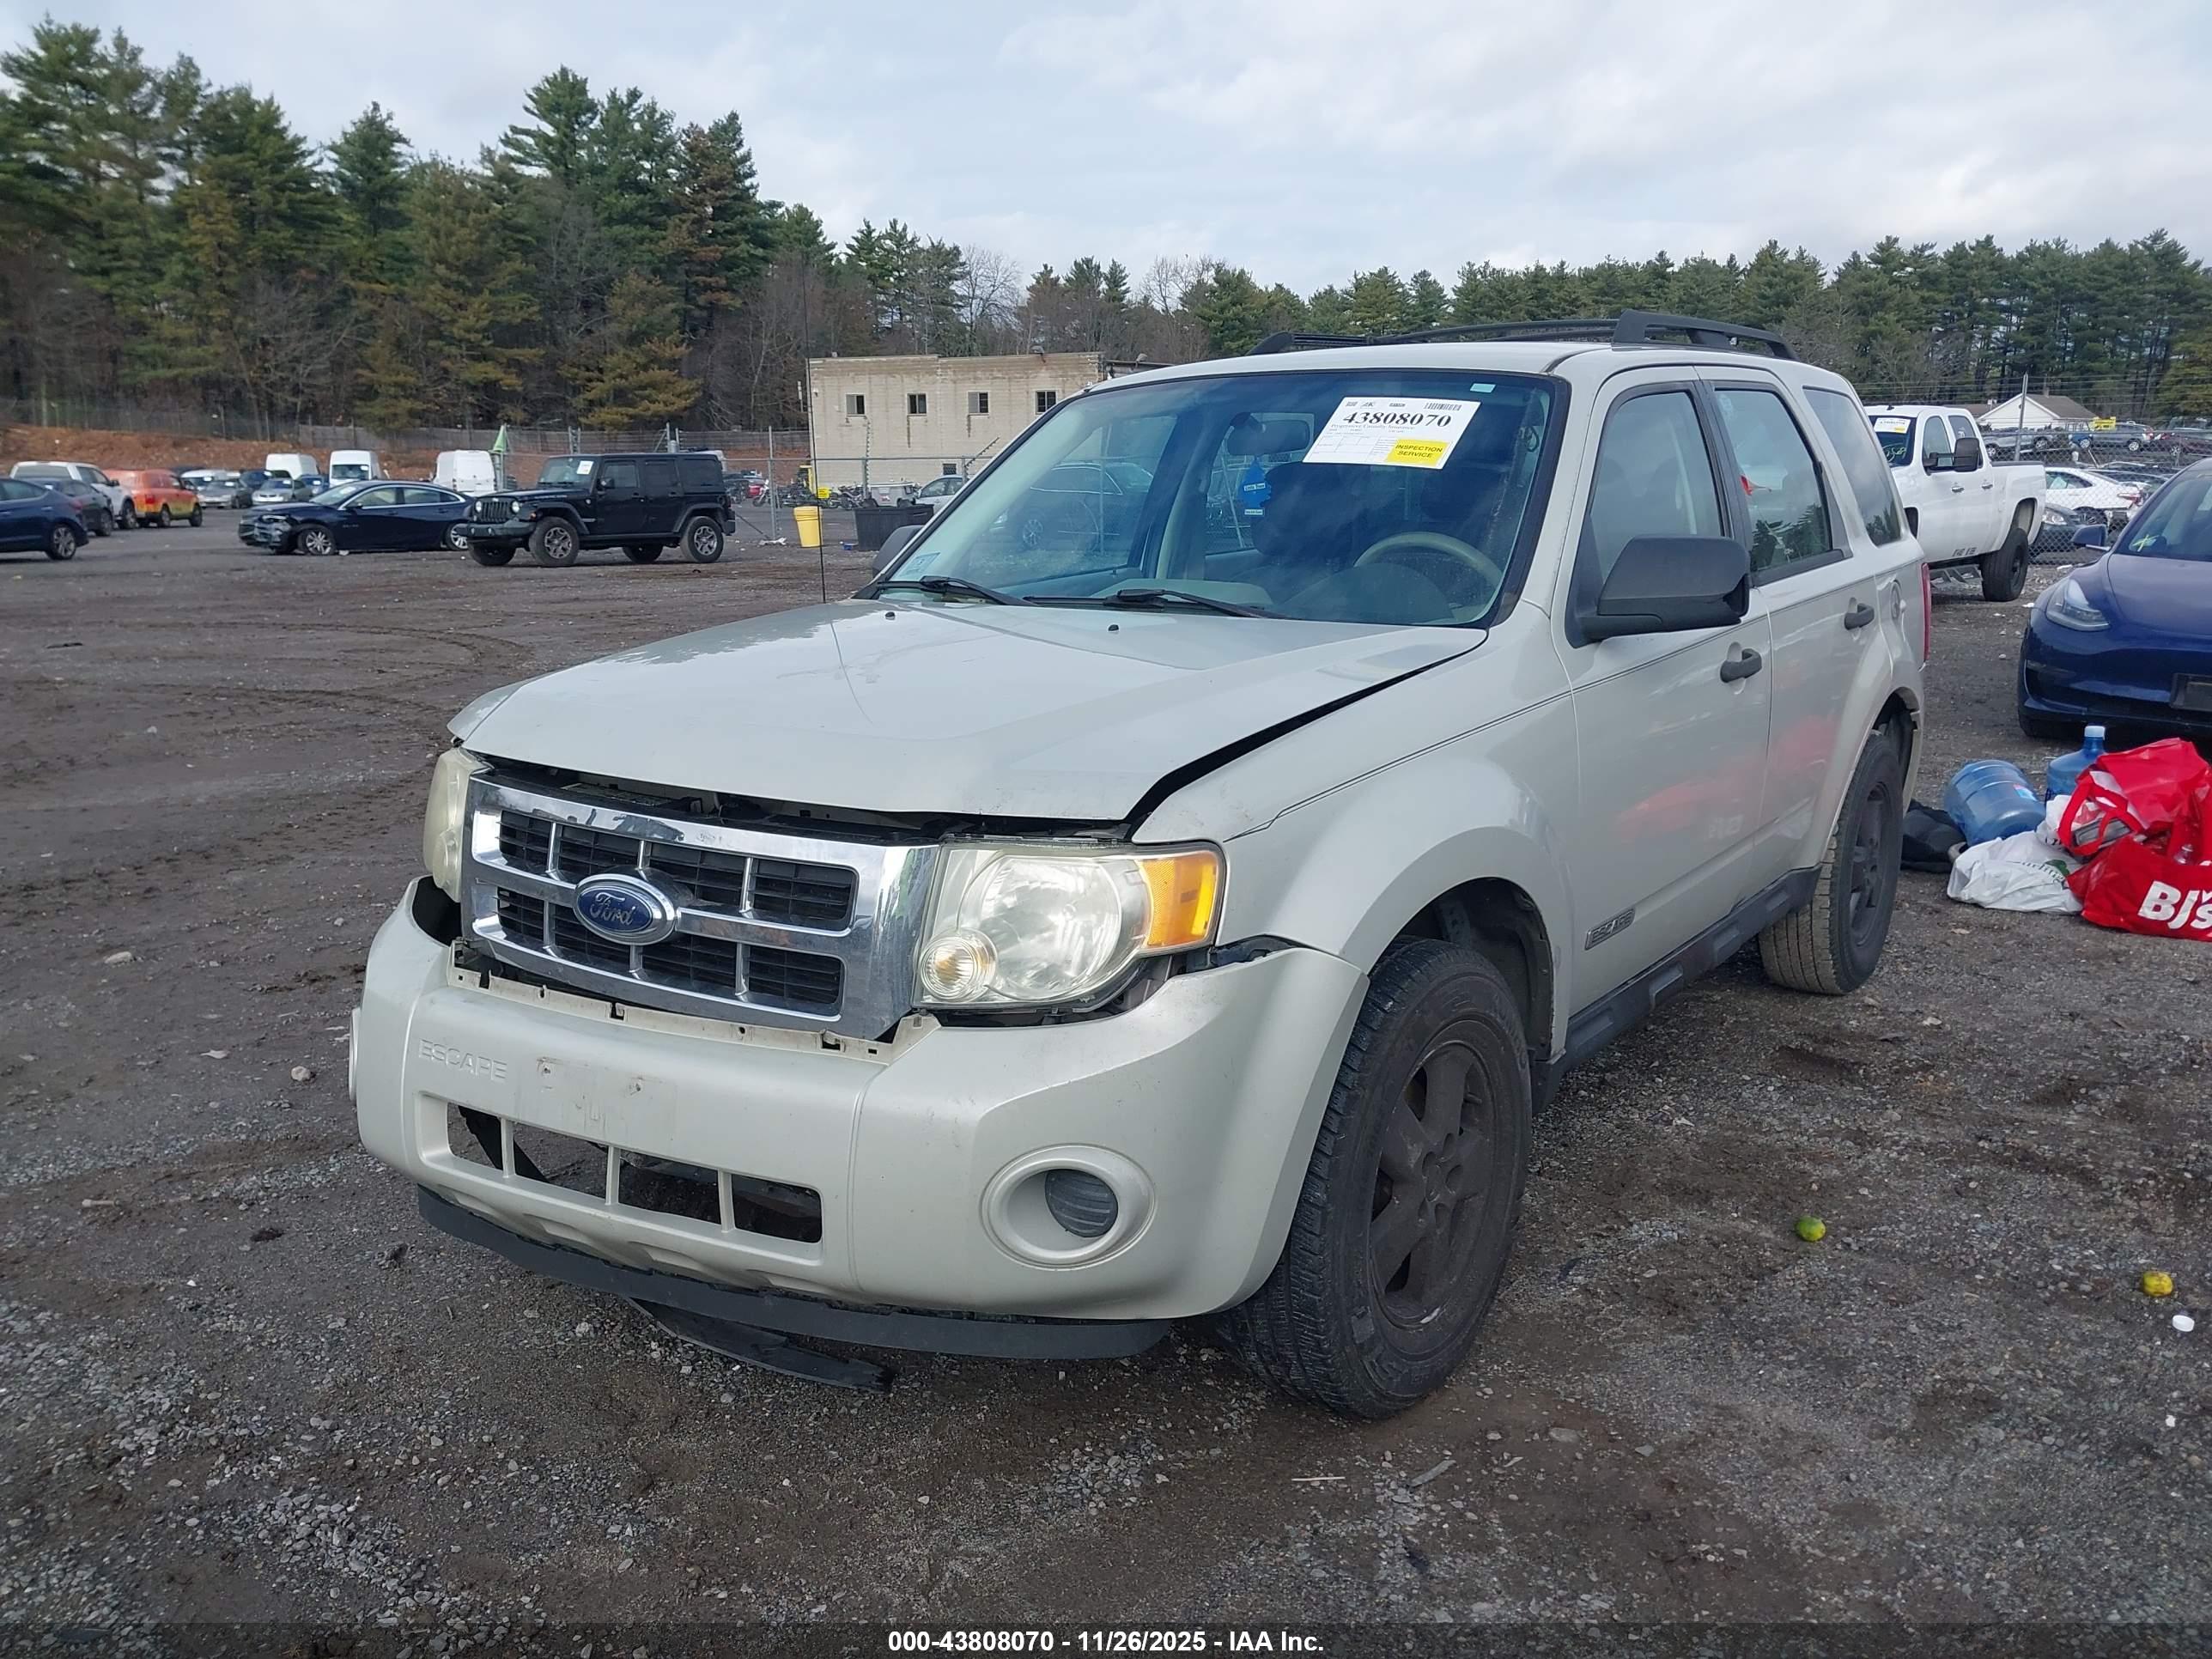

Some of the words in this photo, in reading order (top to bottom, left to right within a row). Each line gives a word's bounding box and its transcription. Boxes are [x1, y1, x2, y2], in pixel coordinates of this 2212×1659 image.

[1343, 411, 1451, 428] 43808070
[1395, 444, 1443, 453] INSPECTION
[590, 892, 636, 926] Ford
[1589, 910, 1633, 945] ESCAPE
[418, 1038, 507, 1080] ESCAPE
